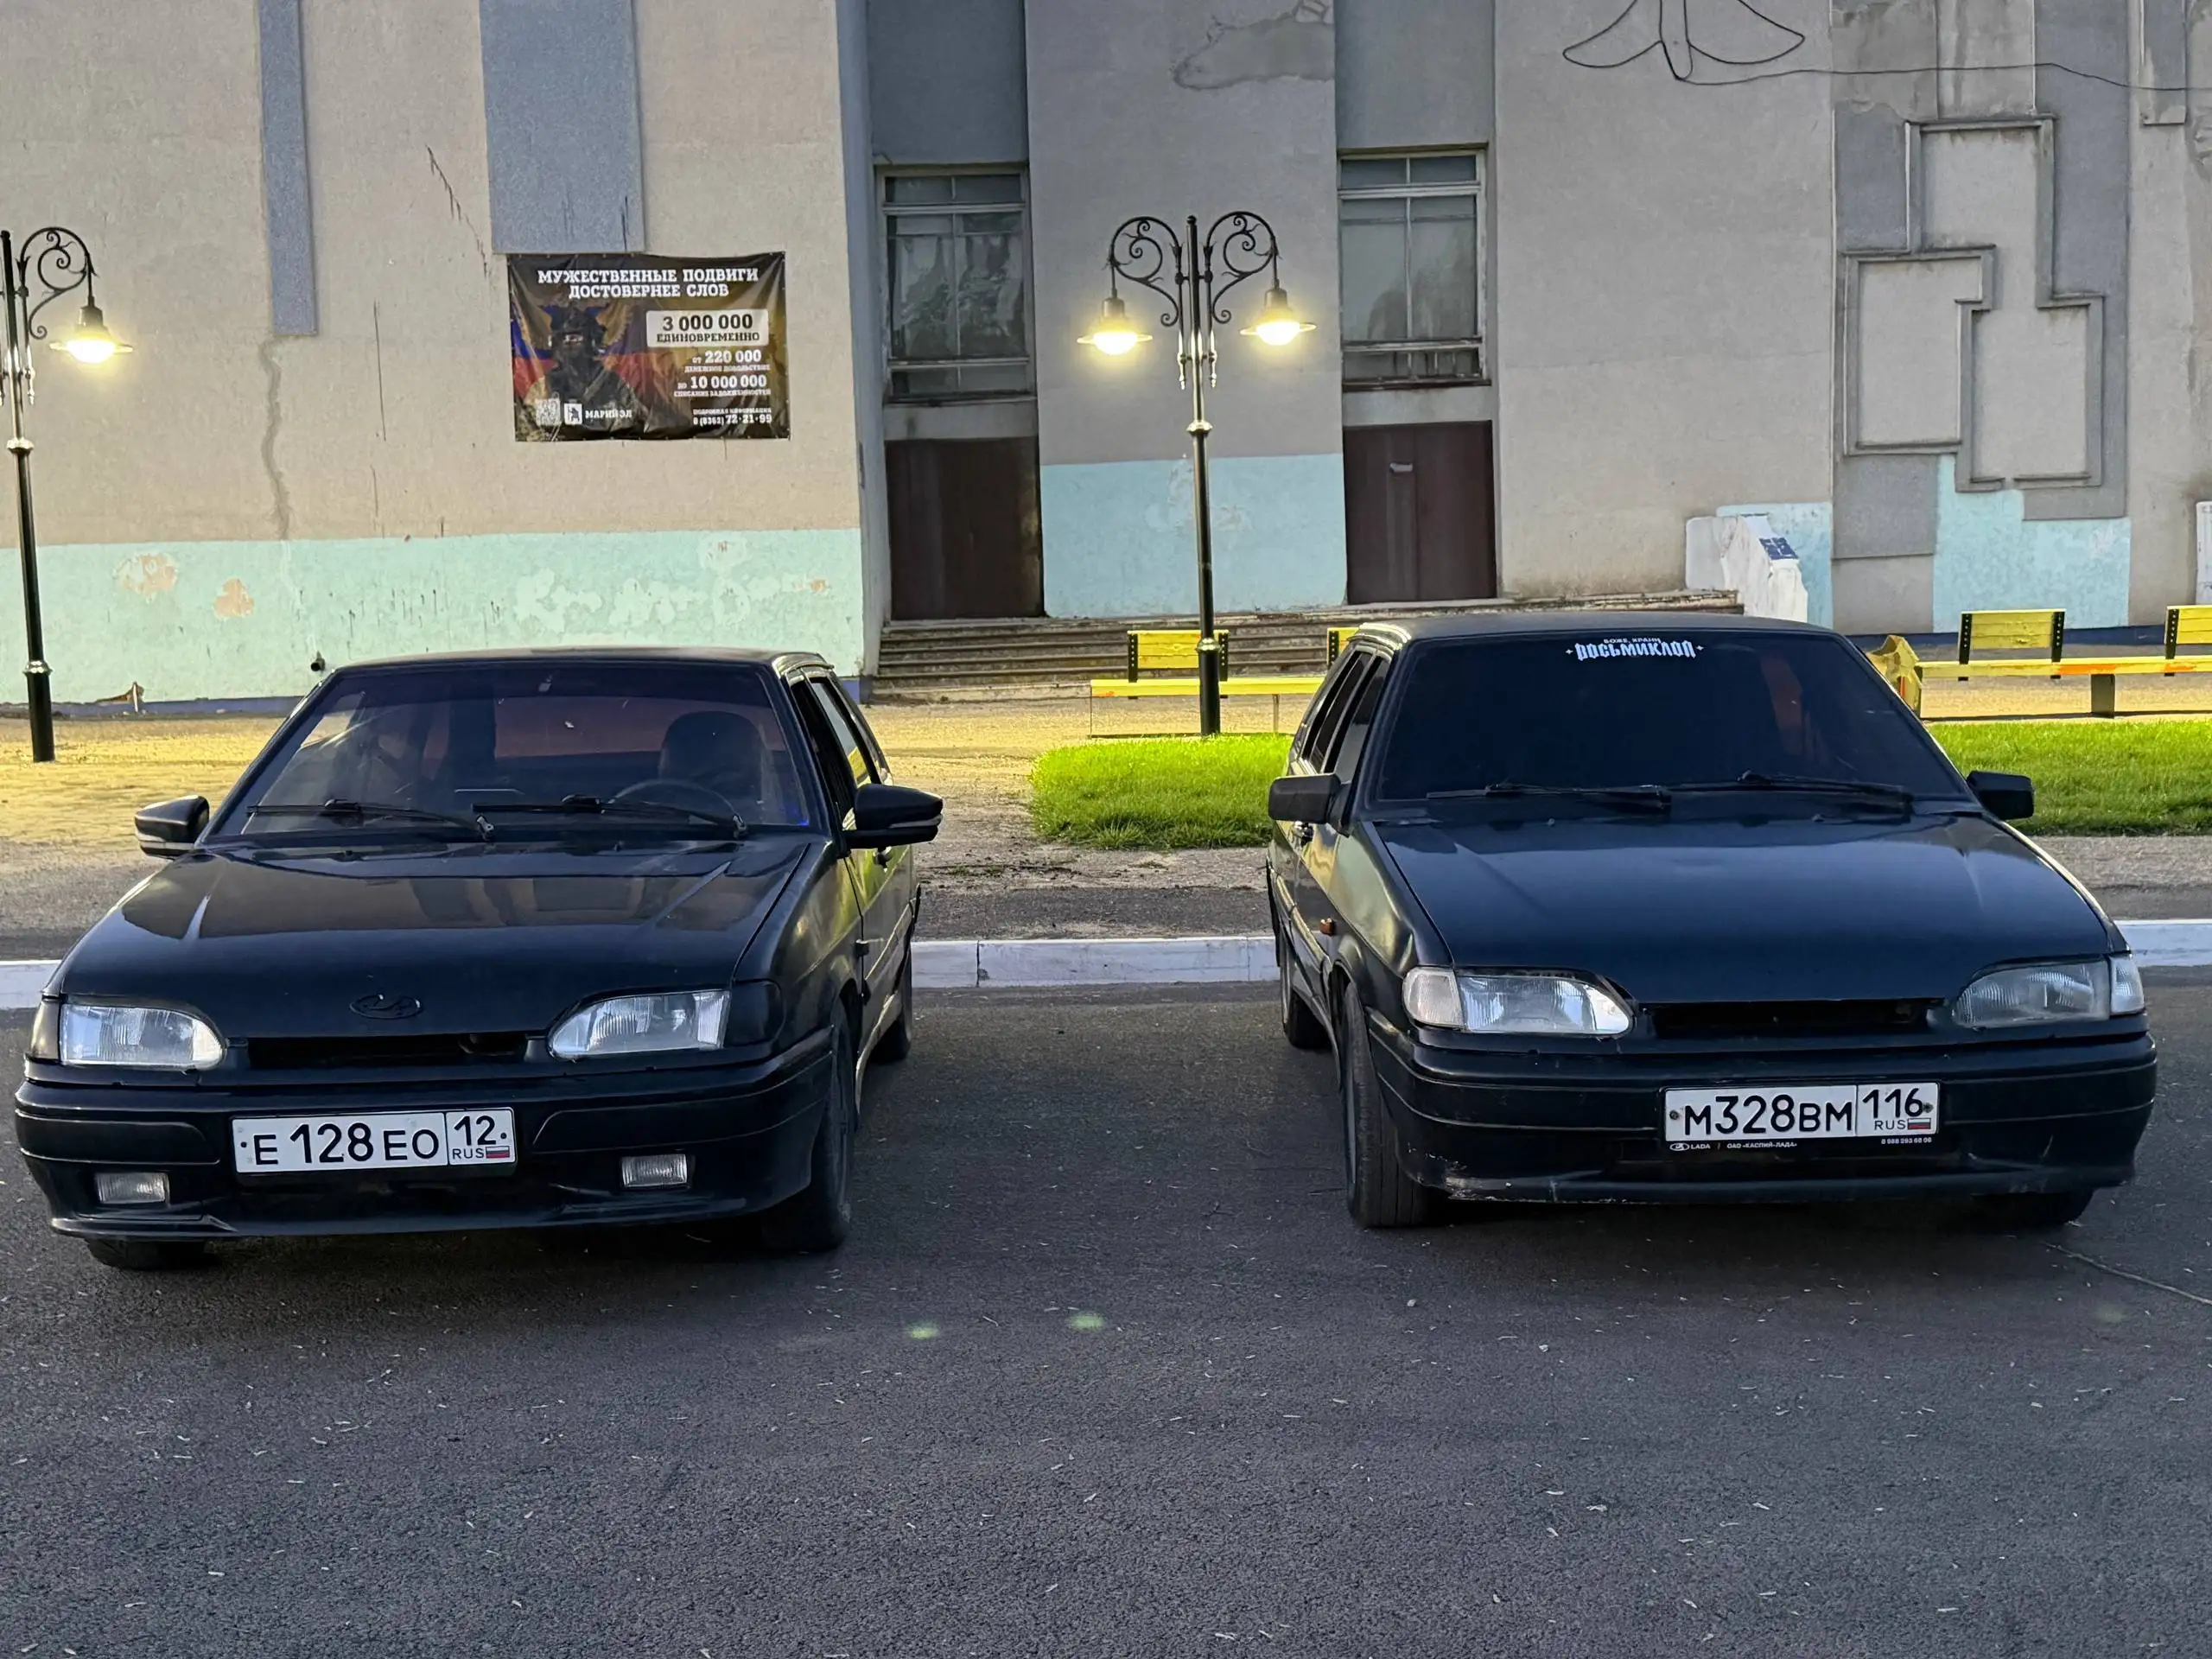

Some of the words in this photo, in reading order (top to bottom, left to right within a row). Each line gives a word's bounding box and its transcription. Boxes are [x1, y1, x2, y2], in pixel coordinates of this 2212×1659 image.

[537, 269, 677, 283] МУЖЕСТВЕННЫЕ
[683, 267, 759, 283] ПОДВИГИ
[569, 284, 681, 300] ДОСТОВЕРНЕЕ
[686, 283, 730, 297] СЛОВ
[663, 316, 673, 331] 3
[679, 315, 713, 331] 000
[719, 314, 753, 329] 000
[656, 332, 760, 343] ЕДИНОВРЕМЕННО
[704, 350, 732, 363] 220
[735, 349, 761, 362] 000
[690, 376, 708, 389] 10
[711, 375, 738, 389] 000
[741, 374, 767, 388] 000
[1684, 1094, 1853, 1135] М328ВМ
[1861, 1087, 1924, 1118] 116
[454, 1115, 497, 1146] 12
[1874, 1119, 1906, 1131] RUS
[452, 1147, 485, 1160] RUS
